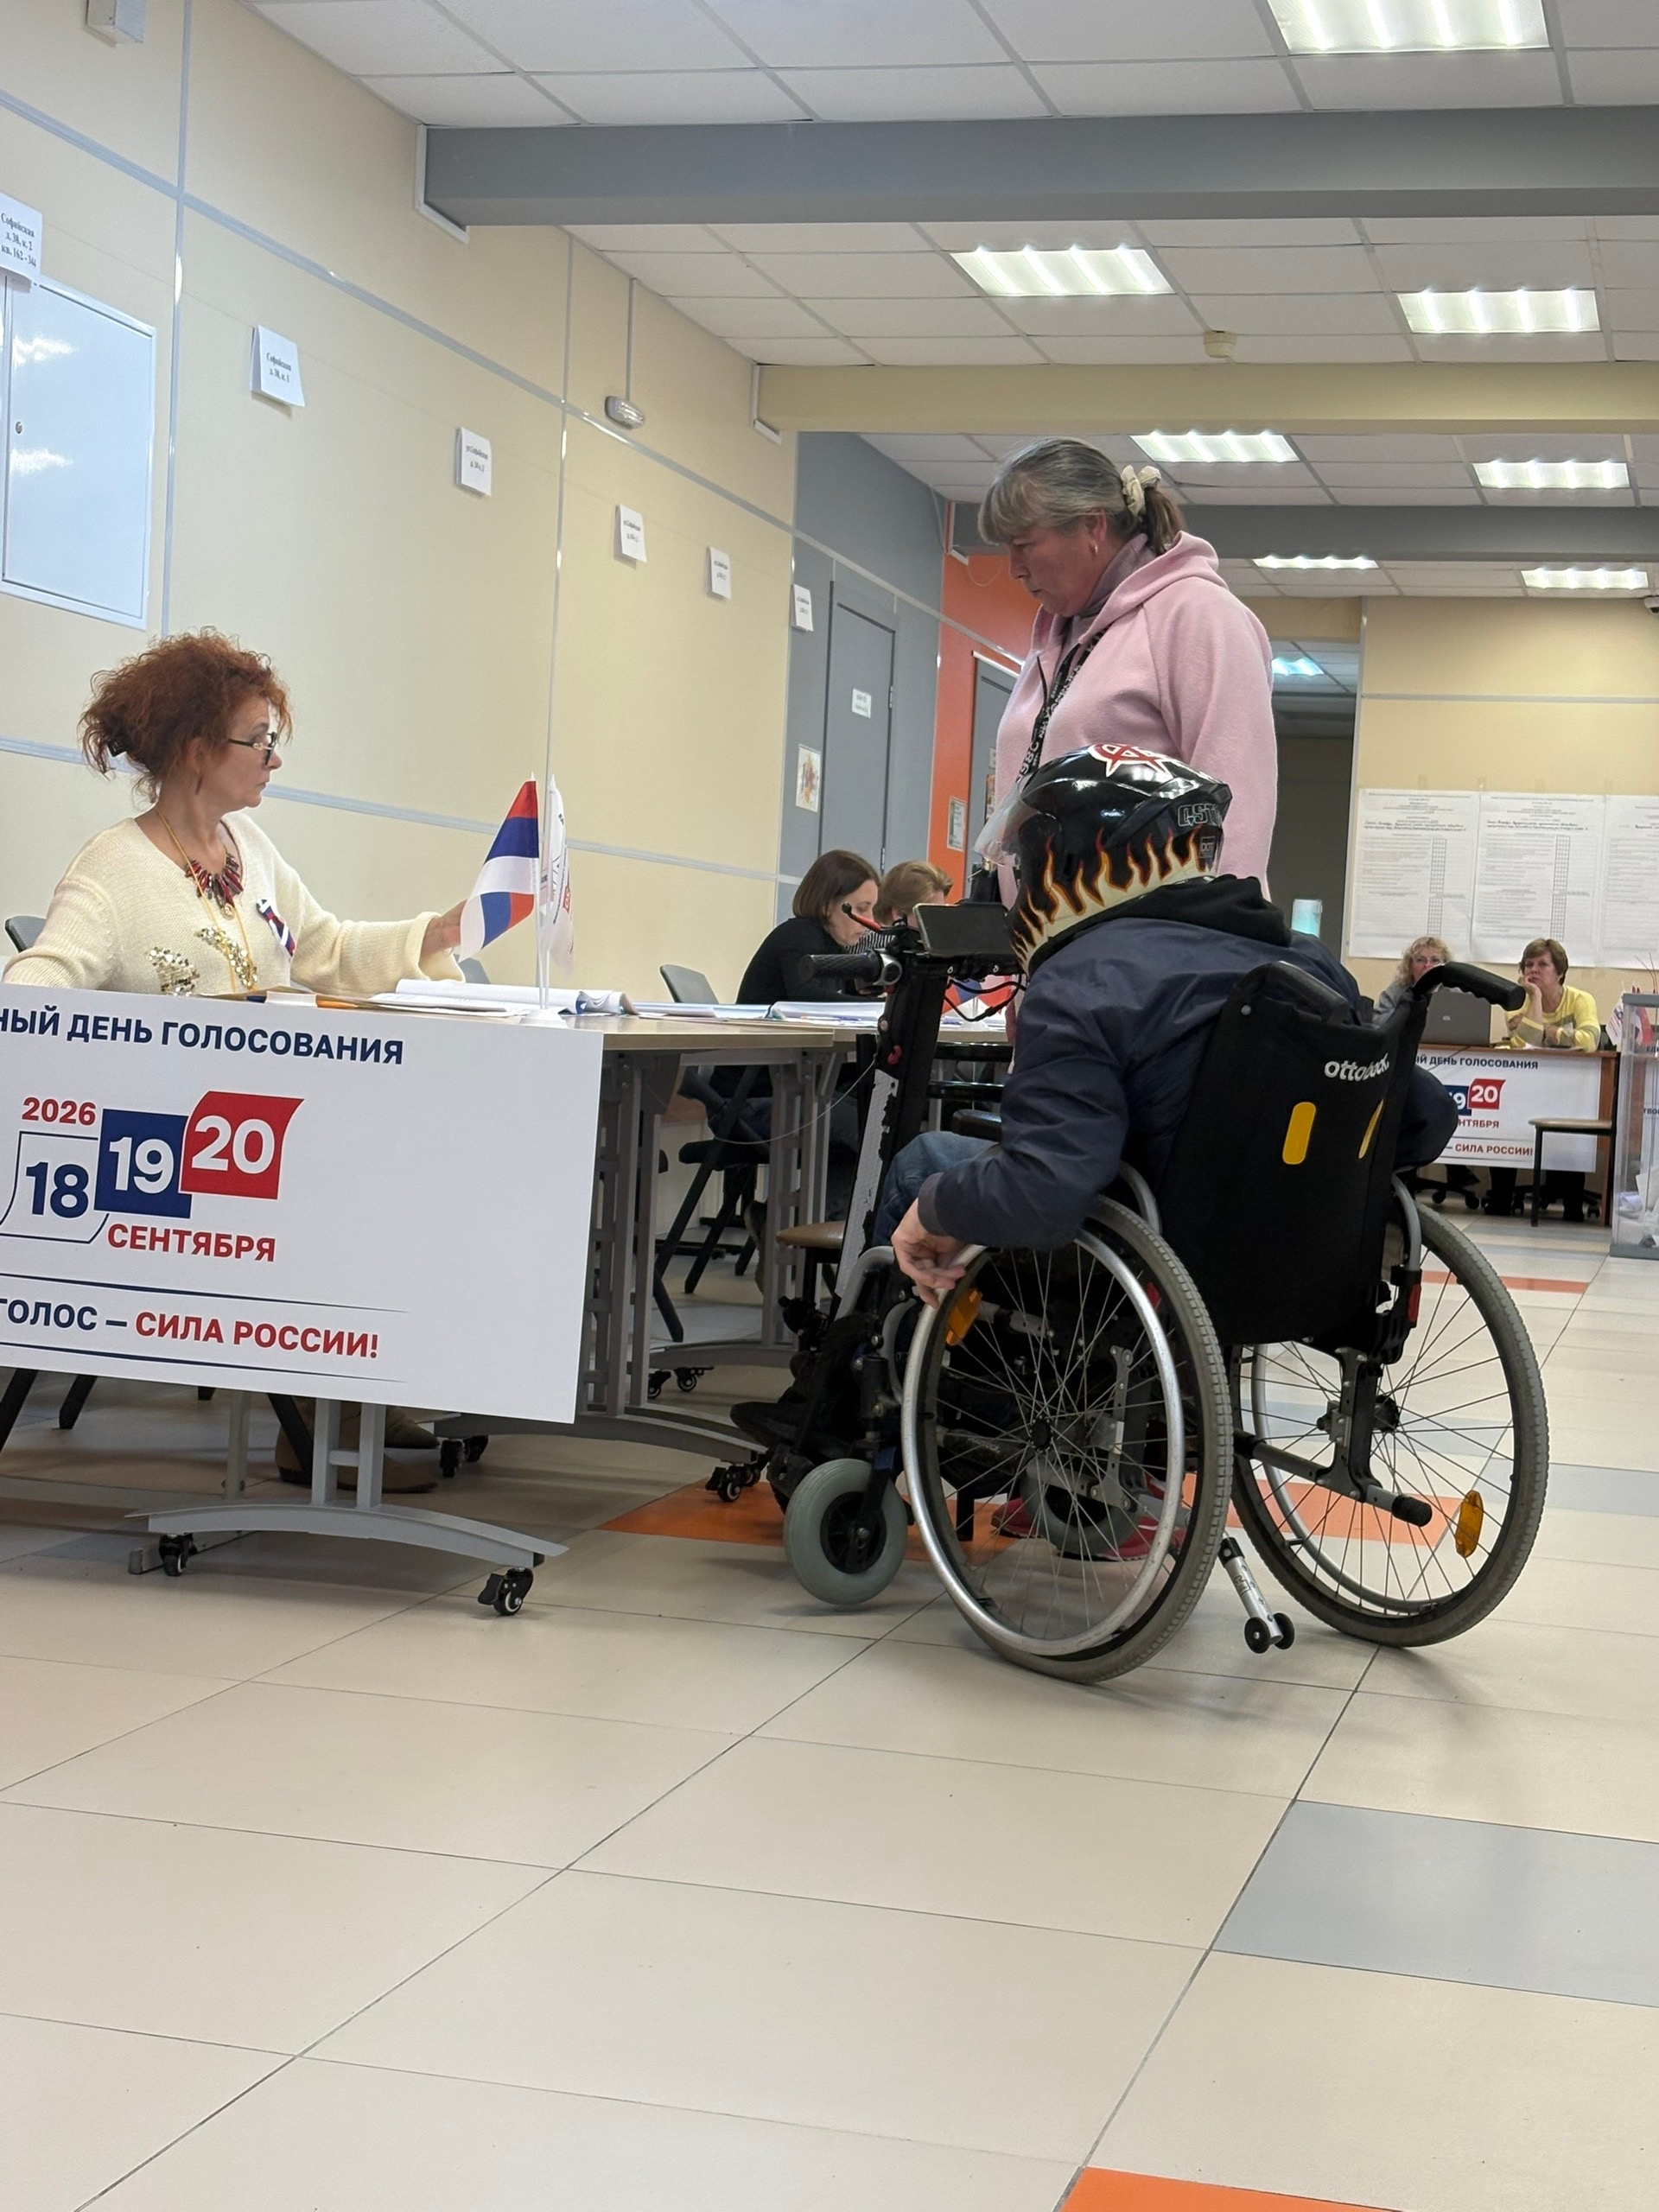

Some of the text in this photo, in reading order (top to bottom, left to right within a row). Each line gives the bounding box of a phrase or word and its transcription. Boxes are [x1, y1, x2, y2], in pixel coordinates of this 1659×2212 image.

[67, 1014, 153, 1044] ДЕНЬ
[162, 1021, 404, 1065] ГОЛОСОВАНИЯ
[1429, 1056, 1457, 1065] ДЕНЬ
[1460, 1058, 1538, 1070] ГОЛОСОВАНИЯ
[22, 1097, 96, 1126] 2026
[1449, 1085, 1498, 1109] 9 20
[1458, 1118, 1500, 1128] НТЯБРЯ
[1455, 1143, 1484, 1154] СИЛА
[1486, 1145, 1533, 1156] РОССИИ!
[25, 1115, 275, 1219] 18 19 20
[108, 1224, 275, 1262] СЕНТЯБРЯ
[136, 1312, 223, 1343] СИЛА
[234, 1321, 378, 1358] РОССИИ!
